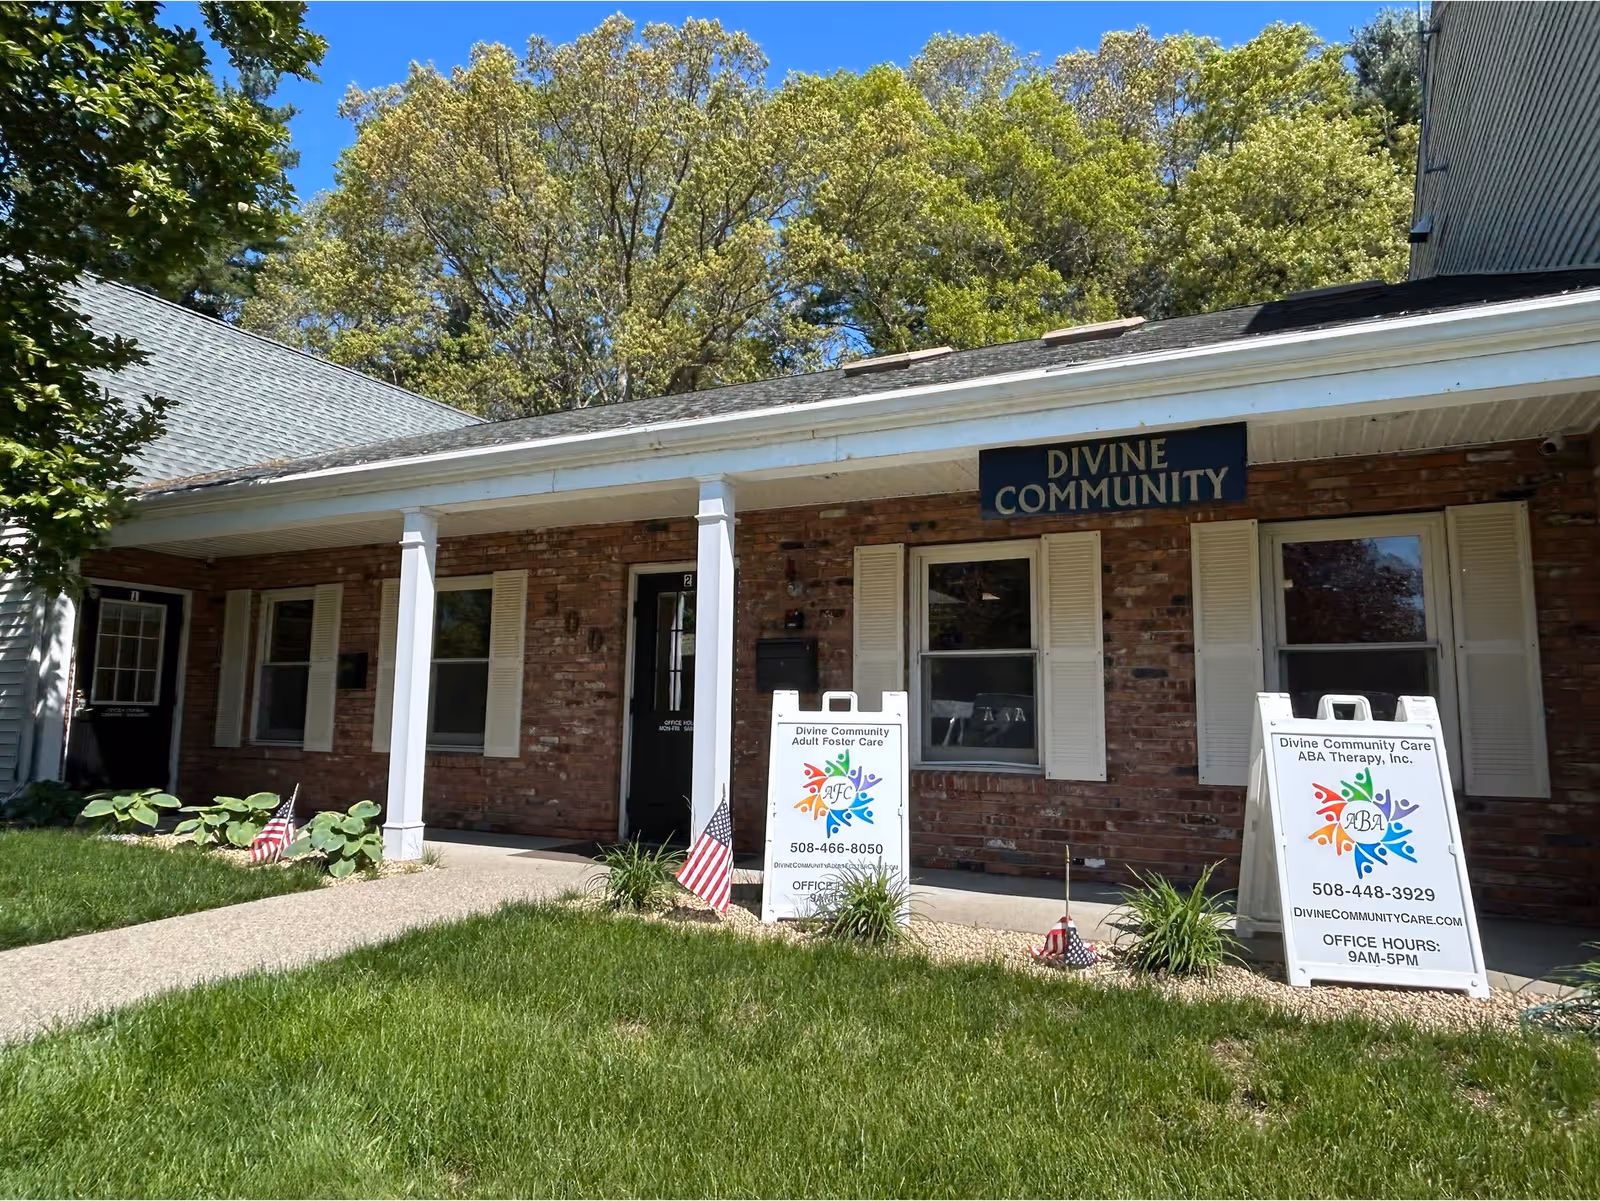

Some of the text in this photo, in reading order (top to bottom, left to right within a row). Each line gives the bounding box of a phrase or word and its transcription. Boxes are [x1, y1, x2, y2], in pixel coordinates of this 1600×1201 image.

[1047, 438, 1168, 479] DIVINE
[994, 467, 1229, 515] COMMUNITY
[795, 726, 890, 738] Divine Community
[791, 736, 884, 747] Adult Foster Care
[1279, 737, 1433, 753] Divine Community Care
[1297, 751, 1414, 766] ABA Therapy, Inc.
[822, 782, 853, 805] AFC
[1344, 809, 1386, 832] ABA
[790, 842, 884, 855] 508-466-8050
[1311, 882, 1436, 902] 508-448-3929
[1322, 933, 1441, 953] OFFICE HOURS:
[1347, 951, 1420, 967] 9AM-5PM
